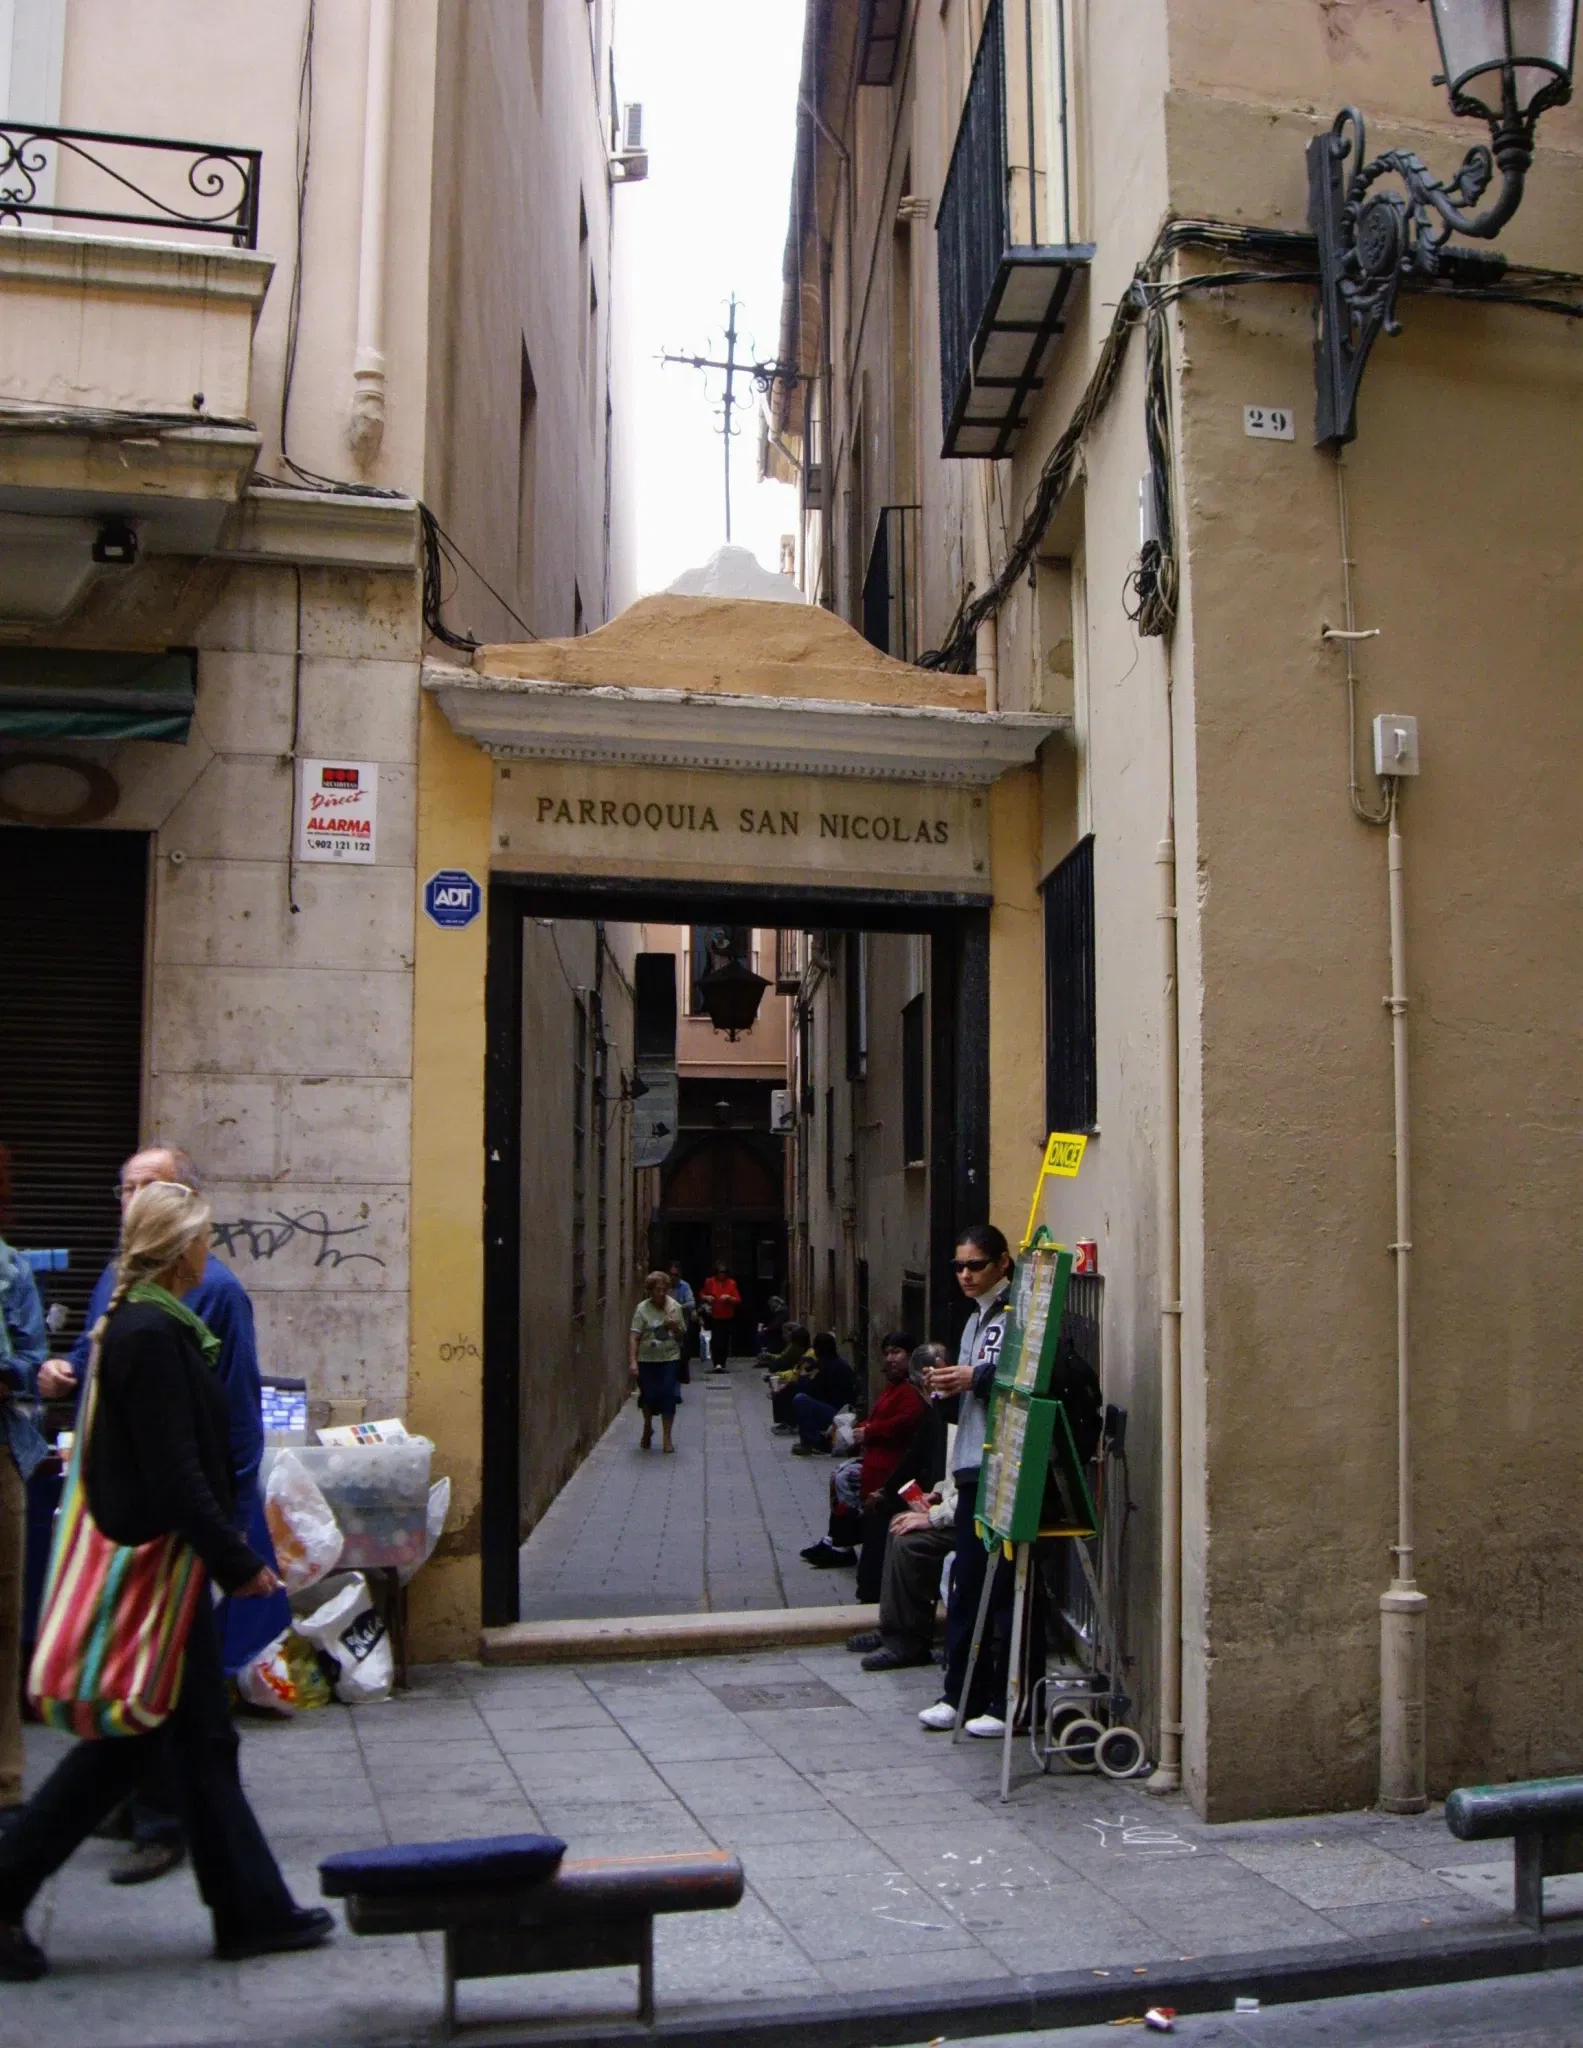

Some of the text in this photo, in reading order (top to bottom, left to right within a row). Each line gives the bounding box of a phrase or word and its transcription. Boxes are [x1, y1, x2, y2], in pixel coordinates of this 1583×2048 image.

[1249, 410, 1286, 431] 29
[310, 790, 368, 811] Direct
[307, 817, 371, 833] ALARMA
[536, 797, 949, 844] PARROQUIA SAN NICOLAS
[315, 840, 370, 851] 902 121 122
[435, 888, 471, 907] ADT
[1049, 1141, 1082, 1168] ONCE
